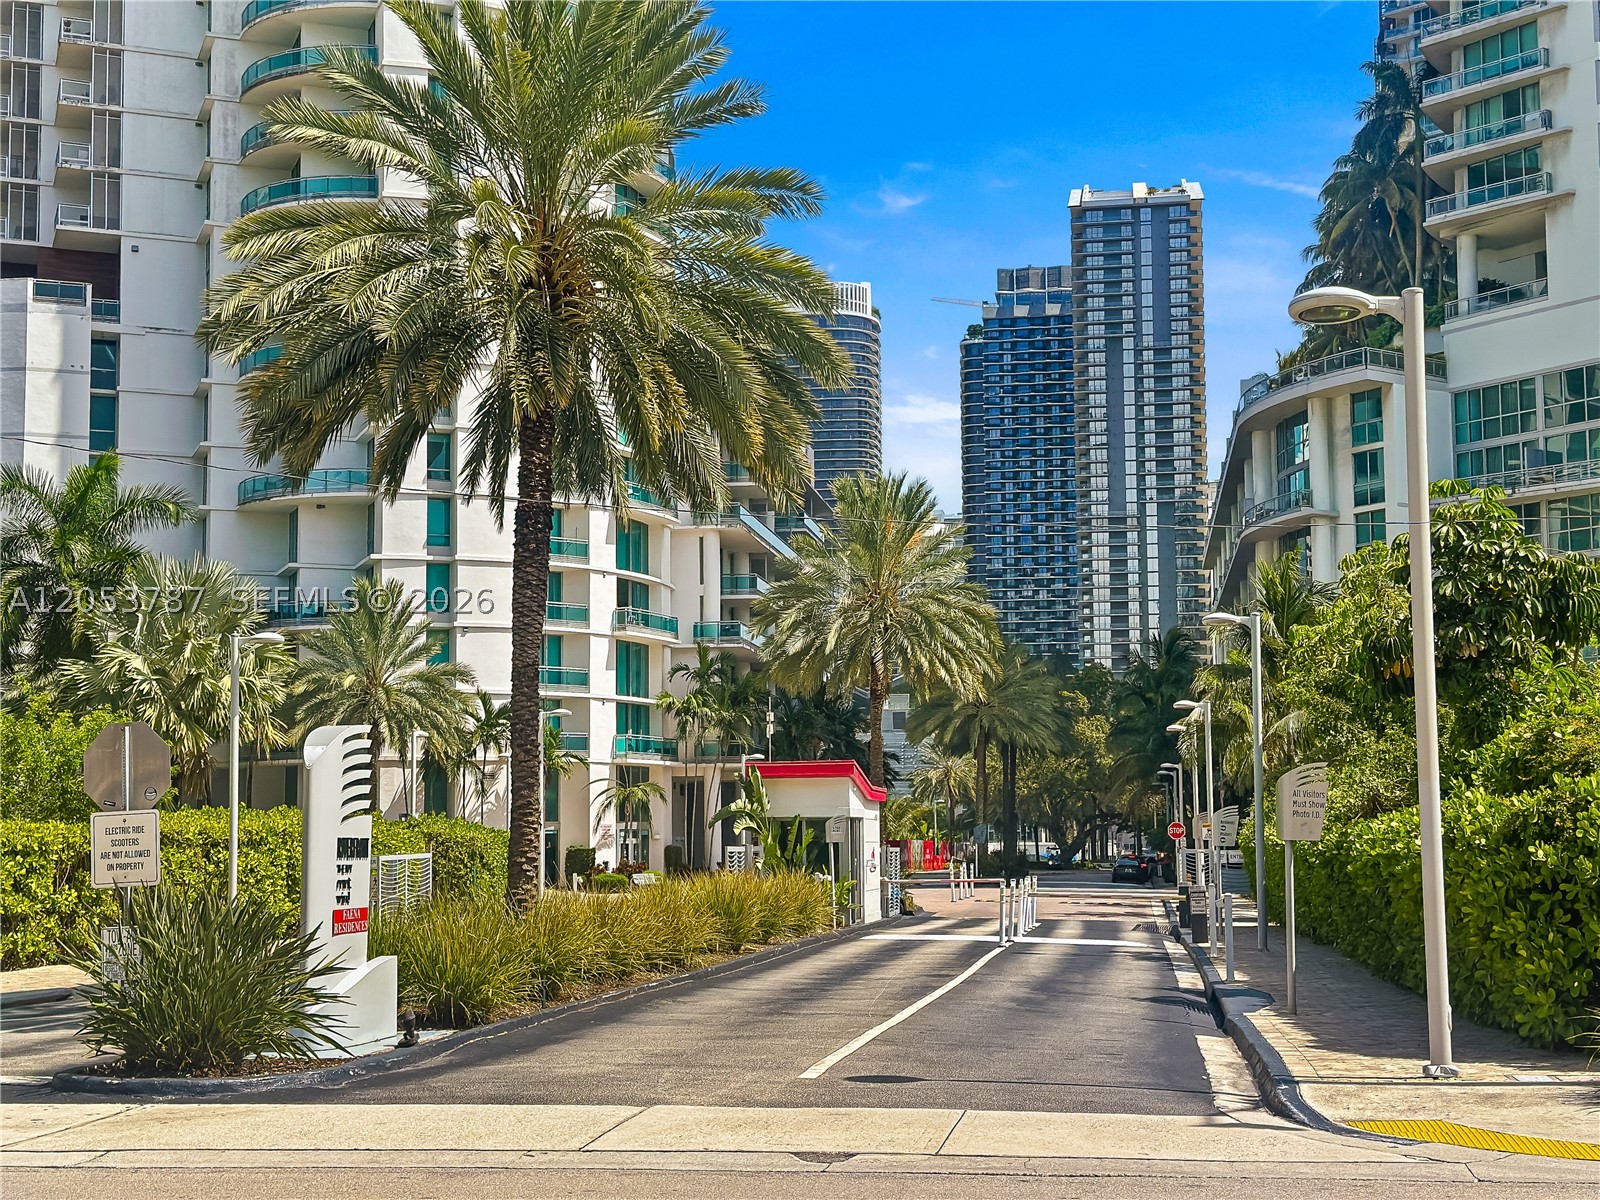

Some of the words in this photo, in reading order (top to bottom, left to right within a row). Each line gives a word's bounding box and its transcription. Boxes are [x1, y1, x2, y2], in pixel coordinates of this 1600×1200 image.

[1292, 789, 1301, 798] All
[1303, 790, 1326, 799] Visitors
[1292, 800, 1307, 808] Must
[1308, 800, 1326, 809] Show
[1292, 810, 1310, 818] Photo
[105, 826, 131, 836] ELECTRIC
[132, 825, 145, 834] RIDE
[1169, 827, 1184, 835] STOP
[110, 838, 140, 848] SCOOTERS
[100, 851, 111, 860] ARE
[112, 850, 123, 859] NOT
[124, 849, 151, 859] ALLOWED
[106, 863, 115, 872] ON
[115, 862, 144, 871] PROPERTY
[343, 908, 361, 920] FAENA
[333, 920, 369, 934] RESIDENCES
